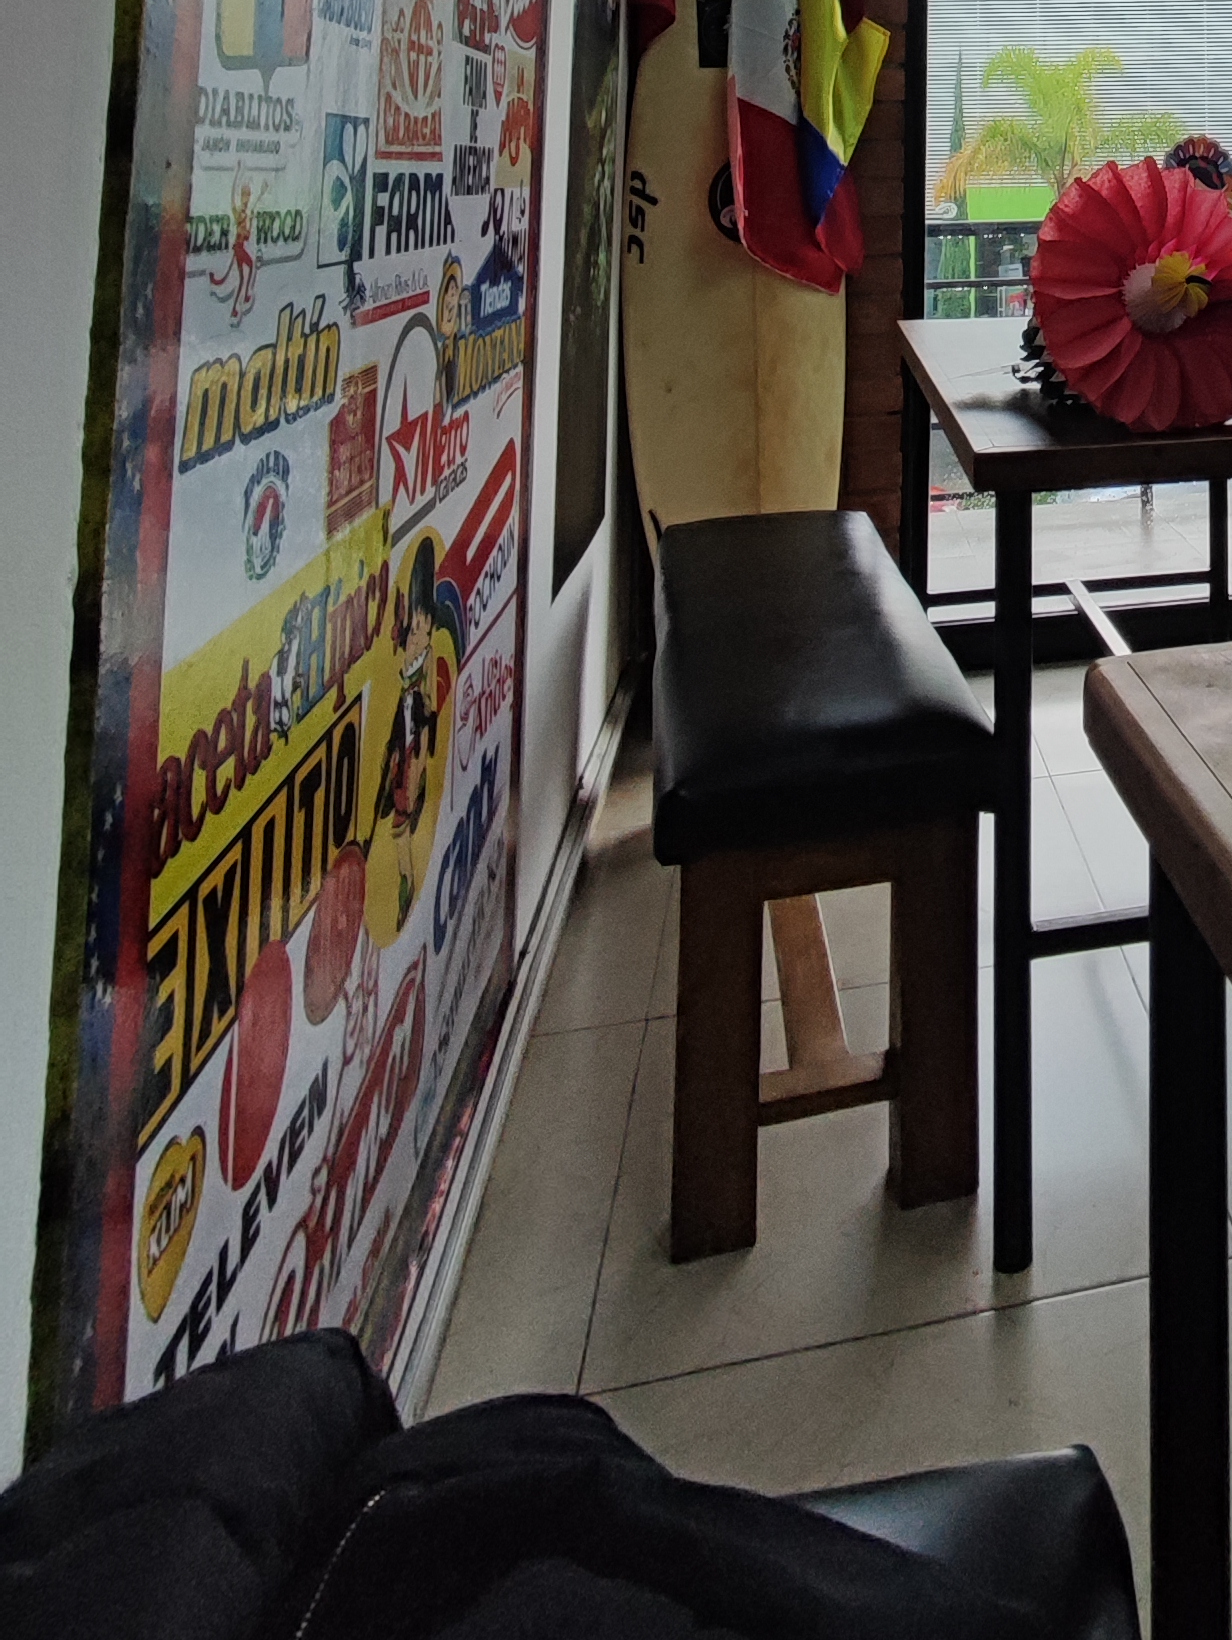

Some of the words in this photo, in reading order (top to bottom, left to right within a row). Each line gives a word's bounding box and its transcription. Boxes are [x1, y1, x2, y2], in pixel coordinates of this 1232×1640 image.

[462, 54, 487, 110] FAMA
[199, 85, 295, 133] DIABLITOS
[384, 92, 442, 146] CARACA
[469, 109, 480, 144] DE
[479, 279, 511, 319] Tiendas
[386, 406, 470, 506] Metro
[438, 458, 469, 503] caracas
[147, 1157, 195, 1275] KLIM
